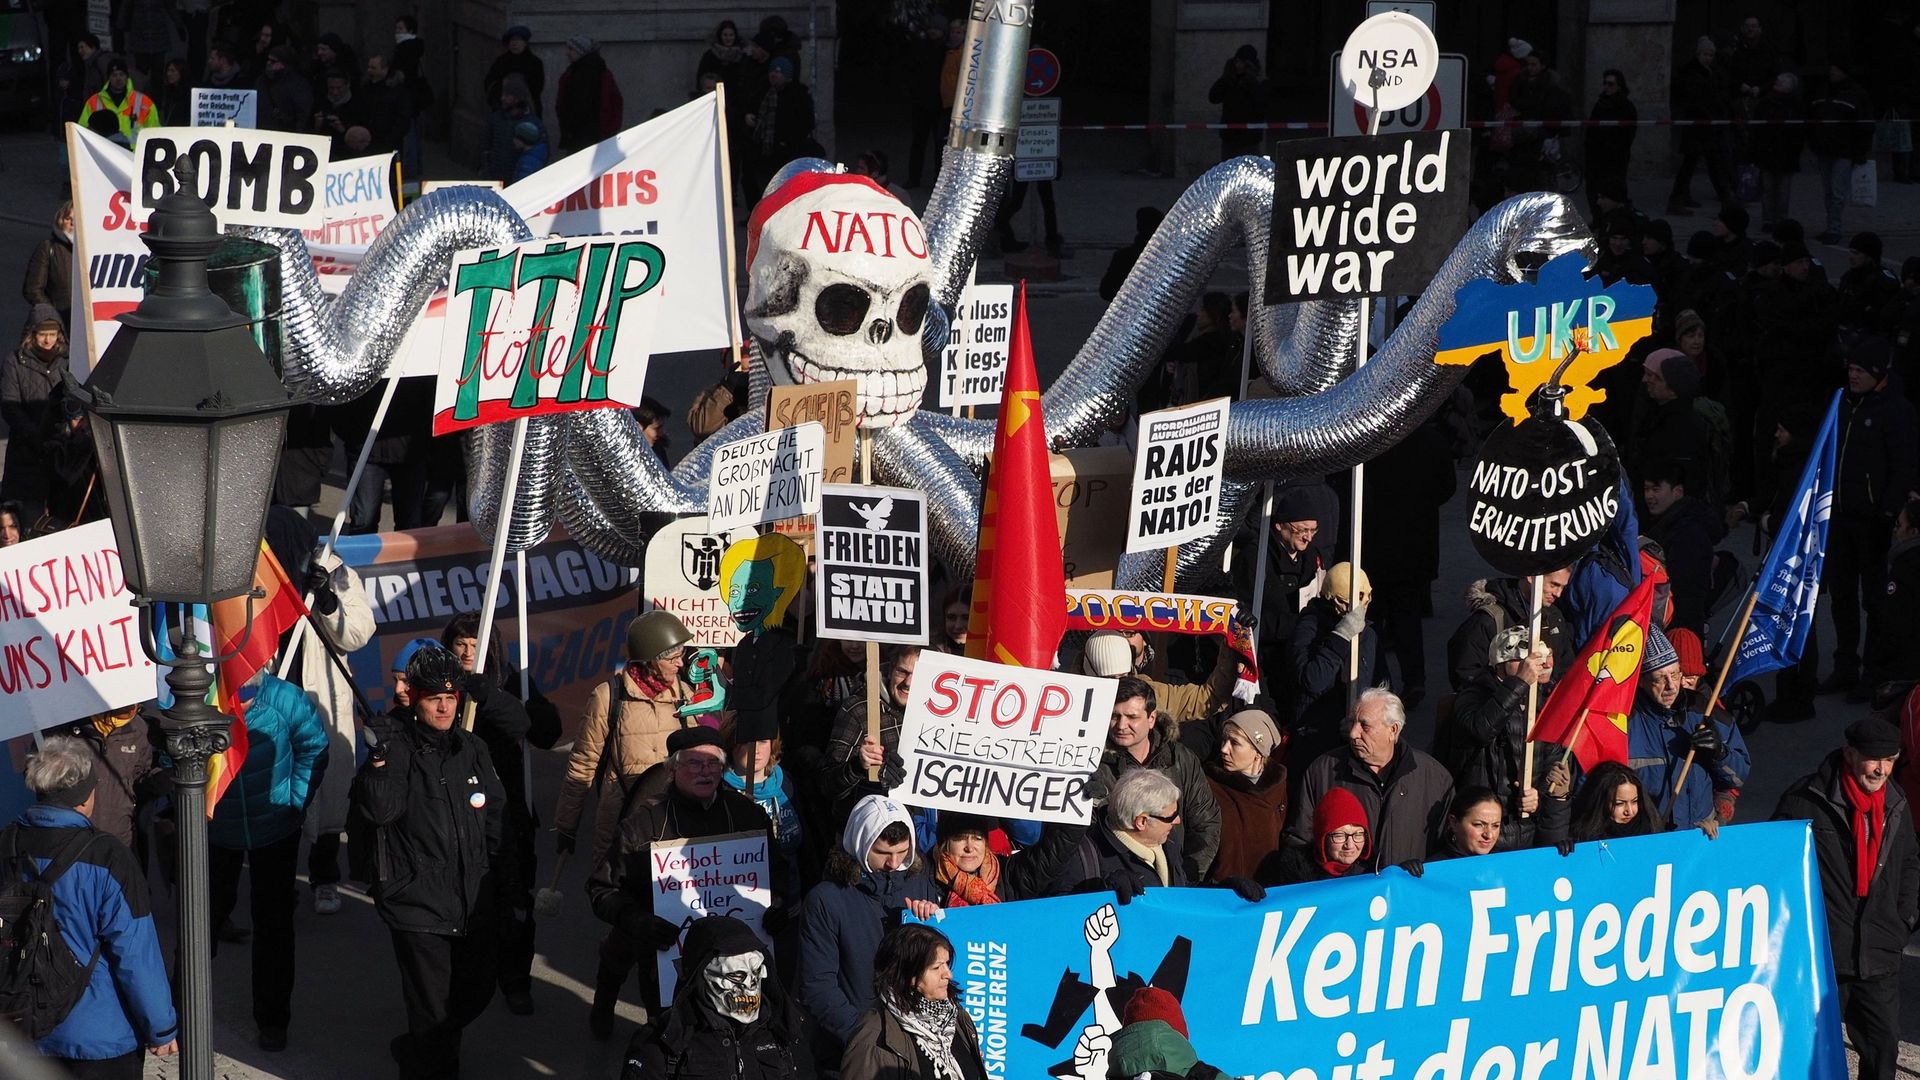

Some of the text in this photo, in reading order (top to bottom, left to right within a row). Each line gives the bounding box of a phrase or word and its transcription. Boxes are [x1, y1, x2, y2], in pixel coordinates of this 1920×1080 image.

[1358, 49, 1418, 69] NSA
[142, 138, 318, 214] BOMB
[1296, 131, 1450, 199] world
[324, 166, 383, 208] RICAN
[801, 210, 928, 259] NATO
[1293, 194, 1417, 248] wide
[1287, 251, 1394, 295] war
[453, 241, 666, 420] TTIP
[455, 296, 617, 385] tötet
[975, 323, 1006, 343] dem
[1507, 295, 1619, 364] UKR
[947, 348, 1007, 371] Kiegs-
[947, 371, 1004, 395] Trror!
[1150, 420, 1218, 441] AUFKÜNDIGEN
[1153, 412, 1218, 432] MORDALLIANZ
[718, 448, 814, 487] GROßMACHT
[720, 431, 798, 463] DEUTSCHE
[1145, 433, 1219, 480] RAUS
[712, 492, 734, 521] AN
[739, 485, 761, 515] DIE
[766, 471, 821, 510] FRONT
[1051, 479, 1108, 508] OP
[1141, 474, 1214, 505] aus der
[1470, 459, 1598, 500] NATO-OST-
[1138, 496, 1213, 538] NATO!
[1470, 486, 1618, 552] ERWEITERUNG
[823, 530, 921, 568] FRIEDEN
[0, 549, 126, 622] HLSTAND
[652, 596, 720, 611] NICHT
[831, 572, 915, 600] STATT
[831, 597, 915, 625] NATO!
[55, 615, 151, 683] KALT.
[911, 758, 1084, 818] ISCHINGER
[654, 842, 765, 874] Verbot und
[657, 868, 758, 894] Vernichtung
[690, 890, 736, 910] aller
[1241, 863, 1770, 1026] Kein Frieden
[966, 941, 987, 1046] EGEN DIE
[1571, 983, 1781, 1080] NATO
